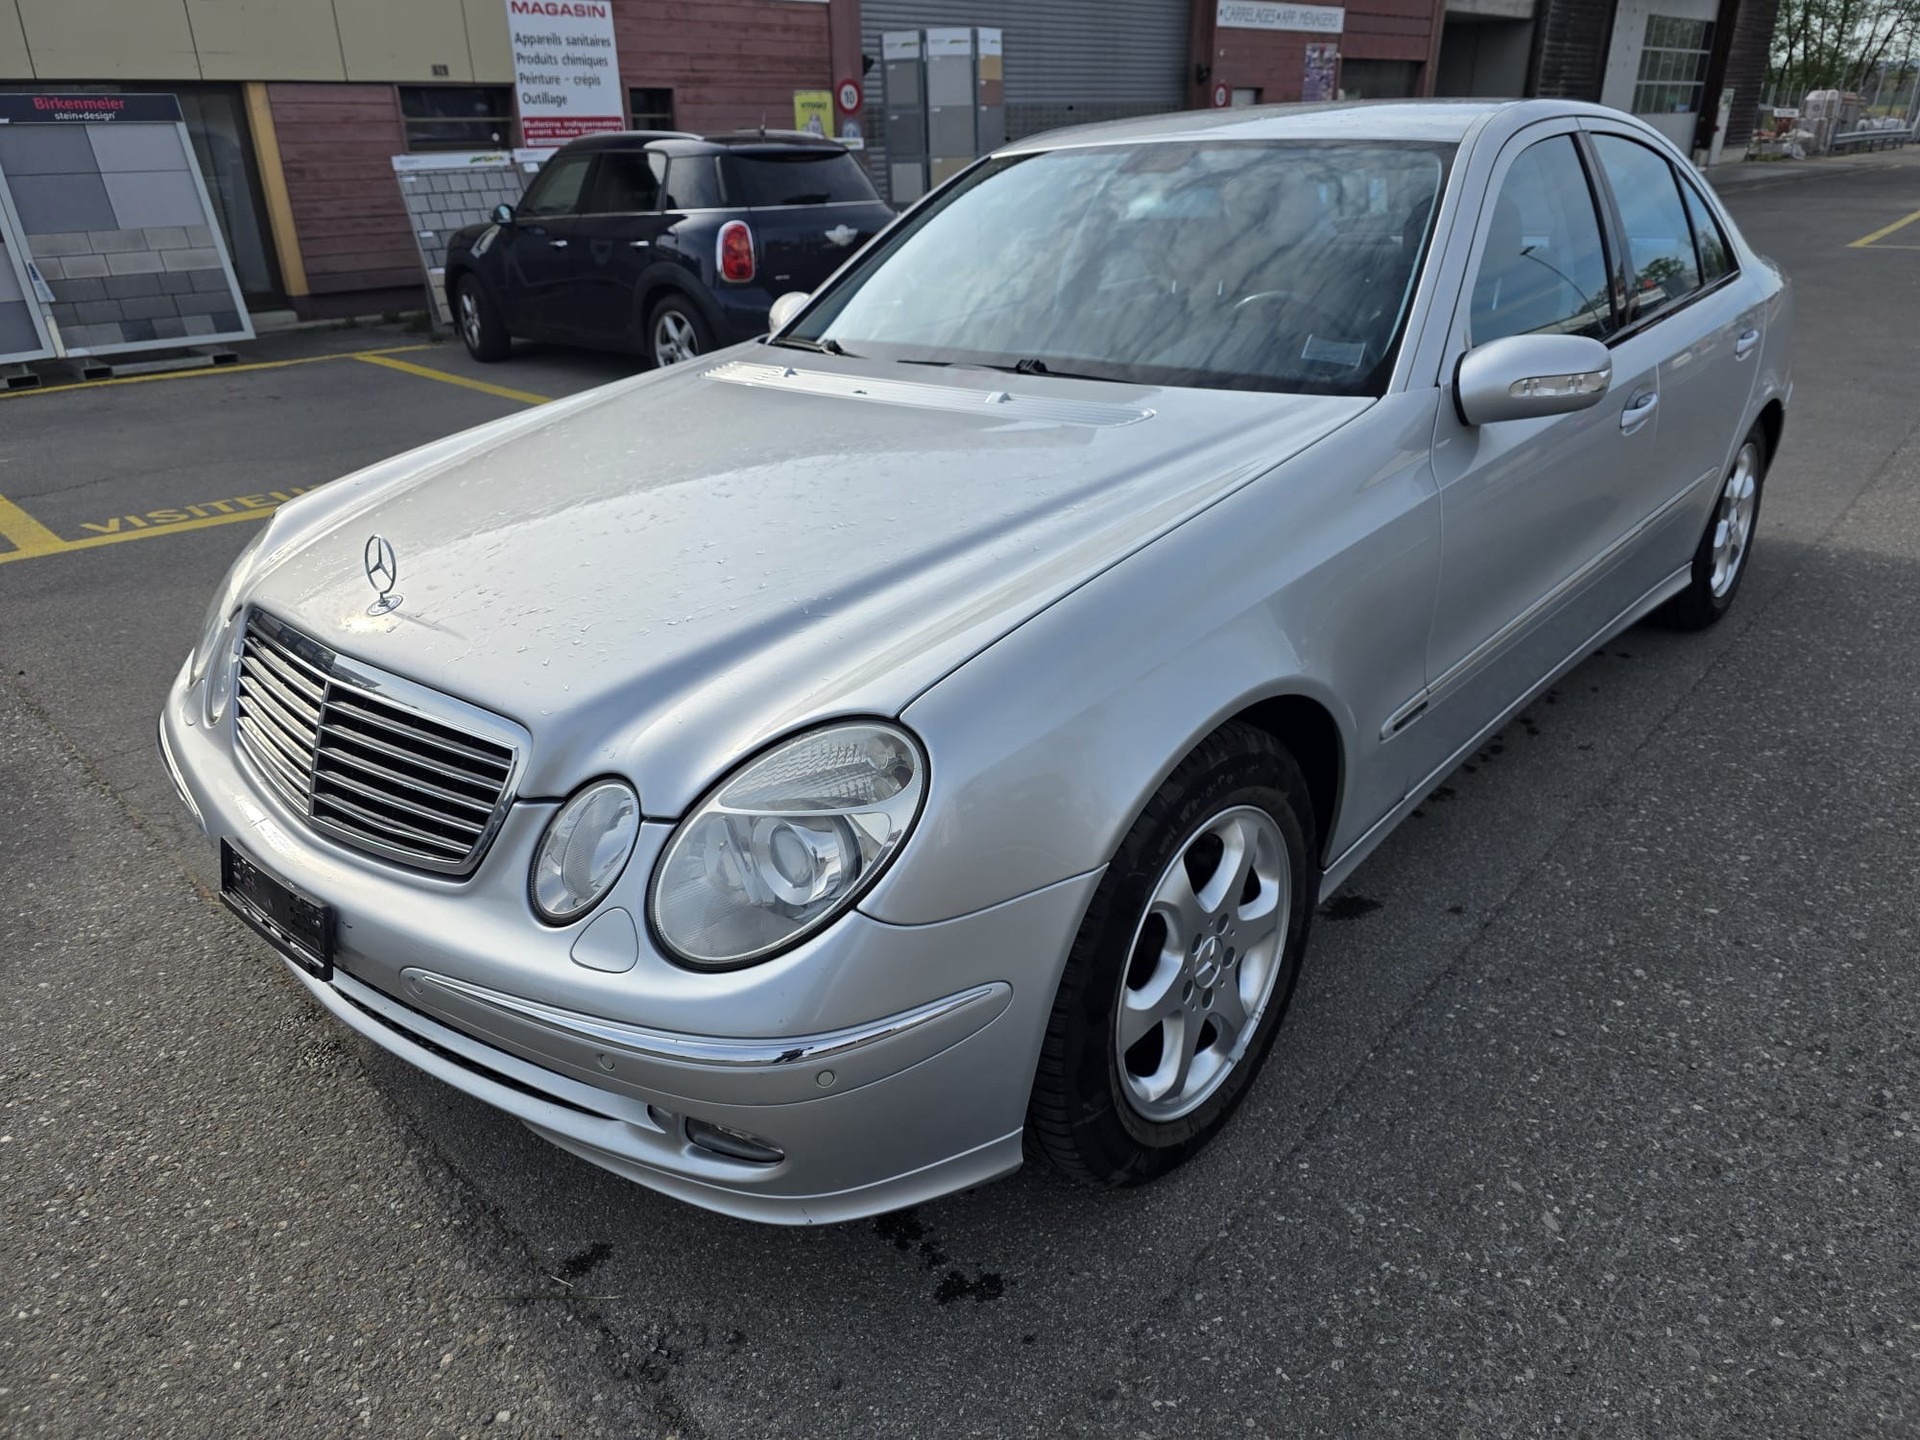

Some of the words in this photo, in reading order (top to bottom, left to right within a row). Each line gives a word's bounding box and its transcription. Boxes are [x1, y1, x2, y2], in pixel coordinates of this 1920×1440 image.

[511, 1, 607, 18] MAGASIN
[514, 33, 562, 47] Appareils
[566, 34, 611, 47] sanitaires
[516, 53, 558, 65] Produits
[562, 53, 608, 69] chimiques
[519, 73, 560, 85] Peinture
[573, 73, 601, 88] crépis
[33, 96, 124, 110] Birkenmeier
[522, 92, 568, 107] Outillage
[844, 90, 856, 105] 10
[79, 484, 320, 534] VISITEU
